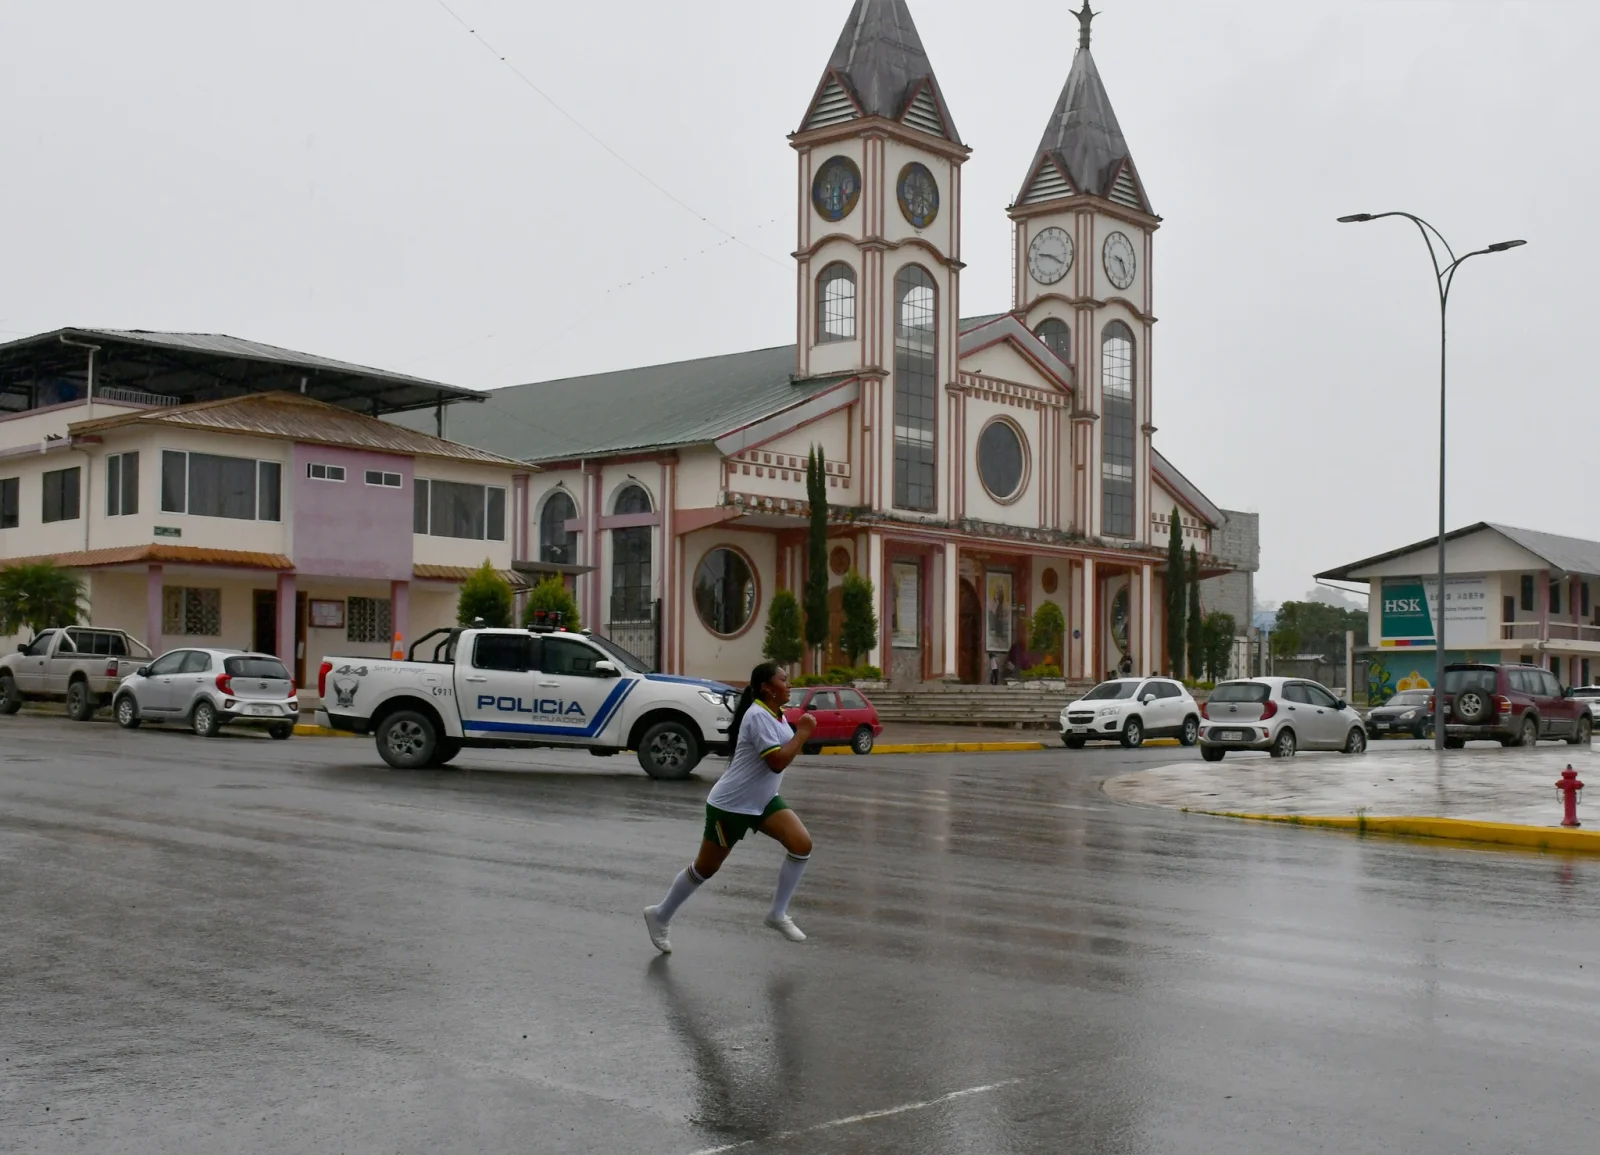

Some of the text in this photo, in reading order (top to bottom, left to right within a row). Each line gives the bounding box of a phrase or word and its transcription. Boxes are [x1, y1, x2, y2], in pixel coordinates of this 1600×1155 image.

[1384, 599, 1422, 613] HSK
[437, 688, 452, 696] 911
[477, 694, 586, 717] POLICÍA
[532, 715, 587, 725] ECUADOR
